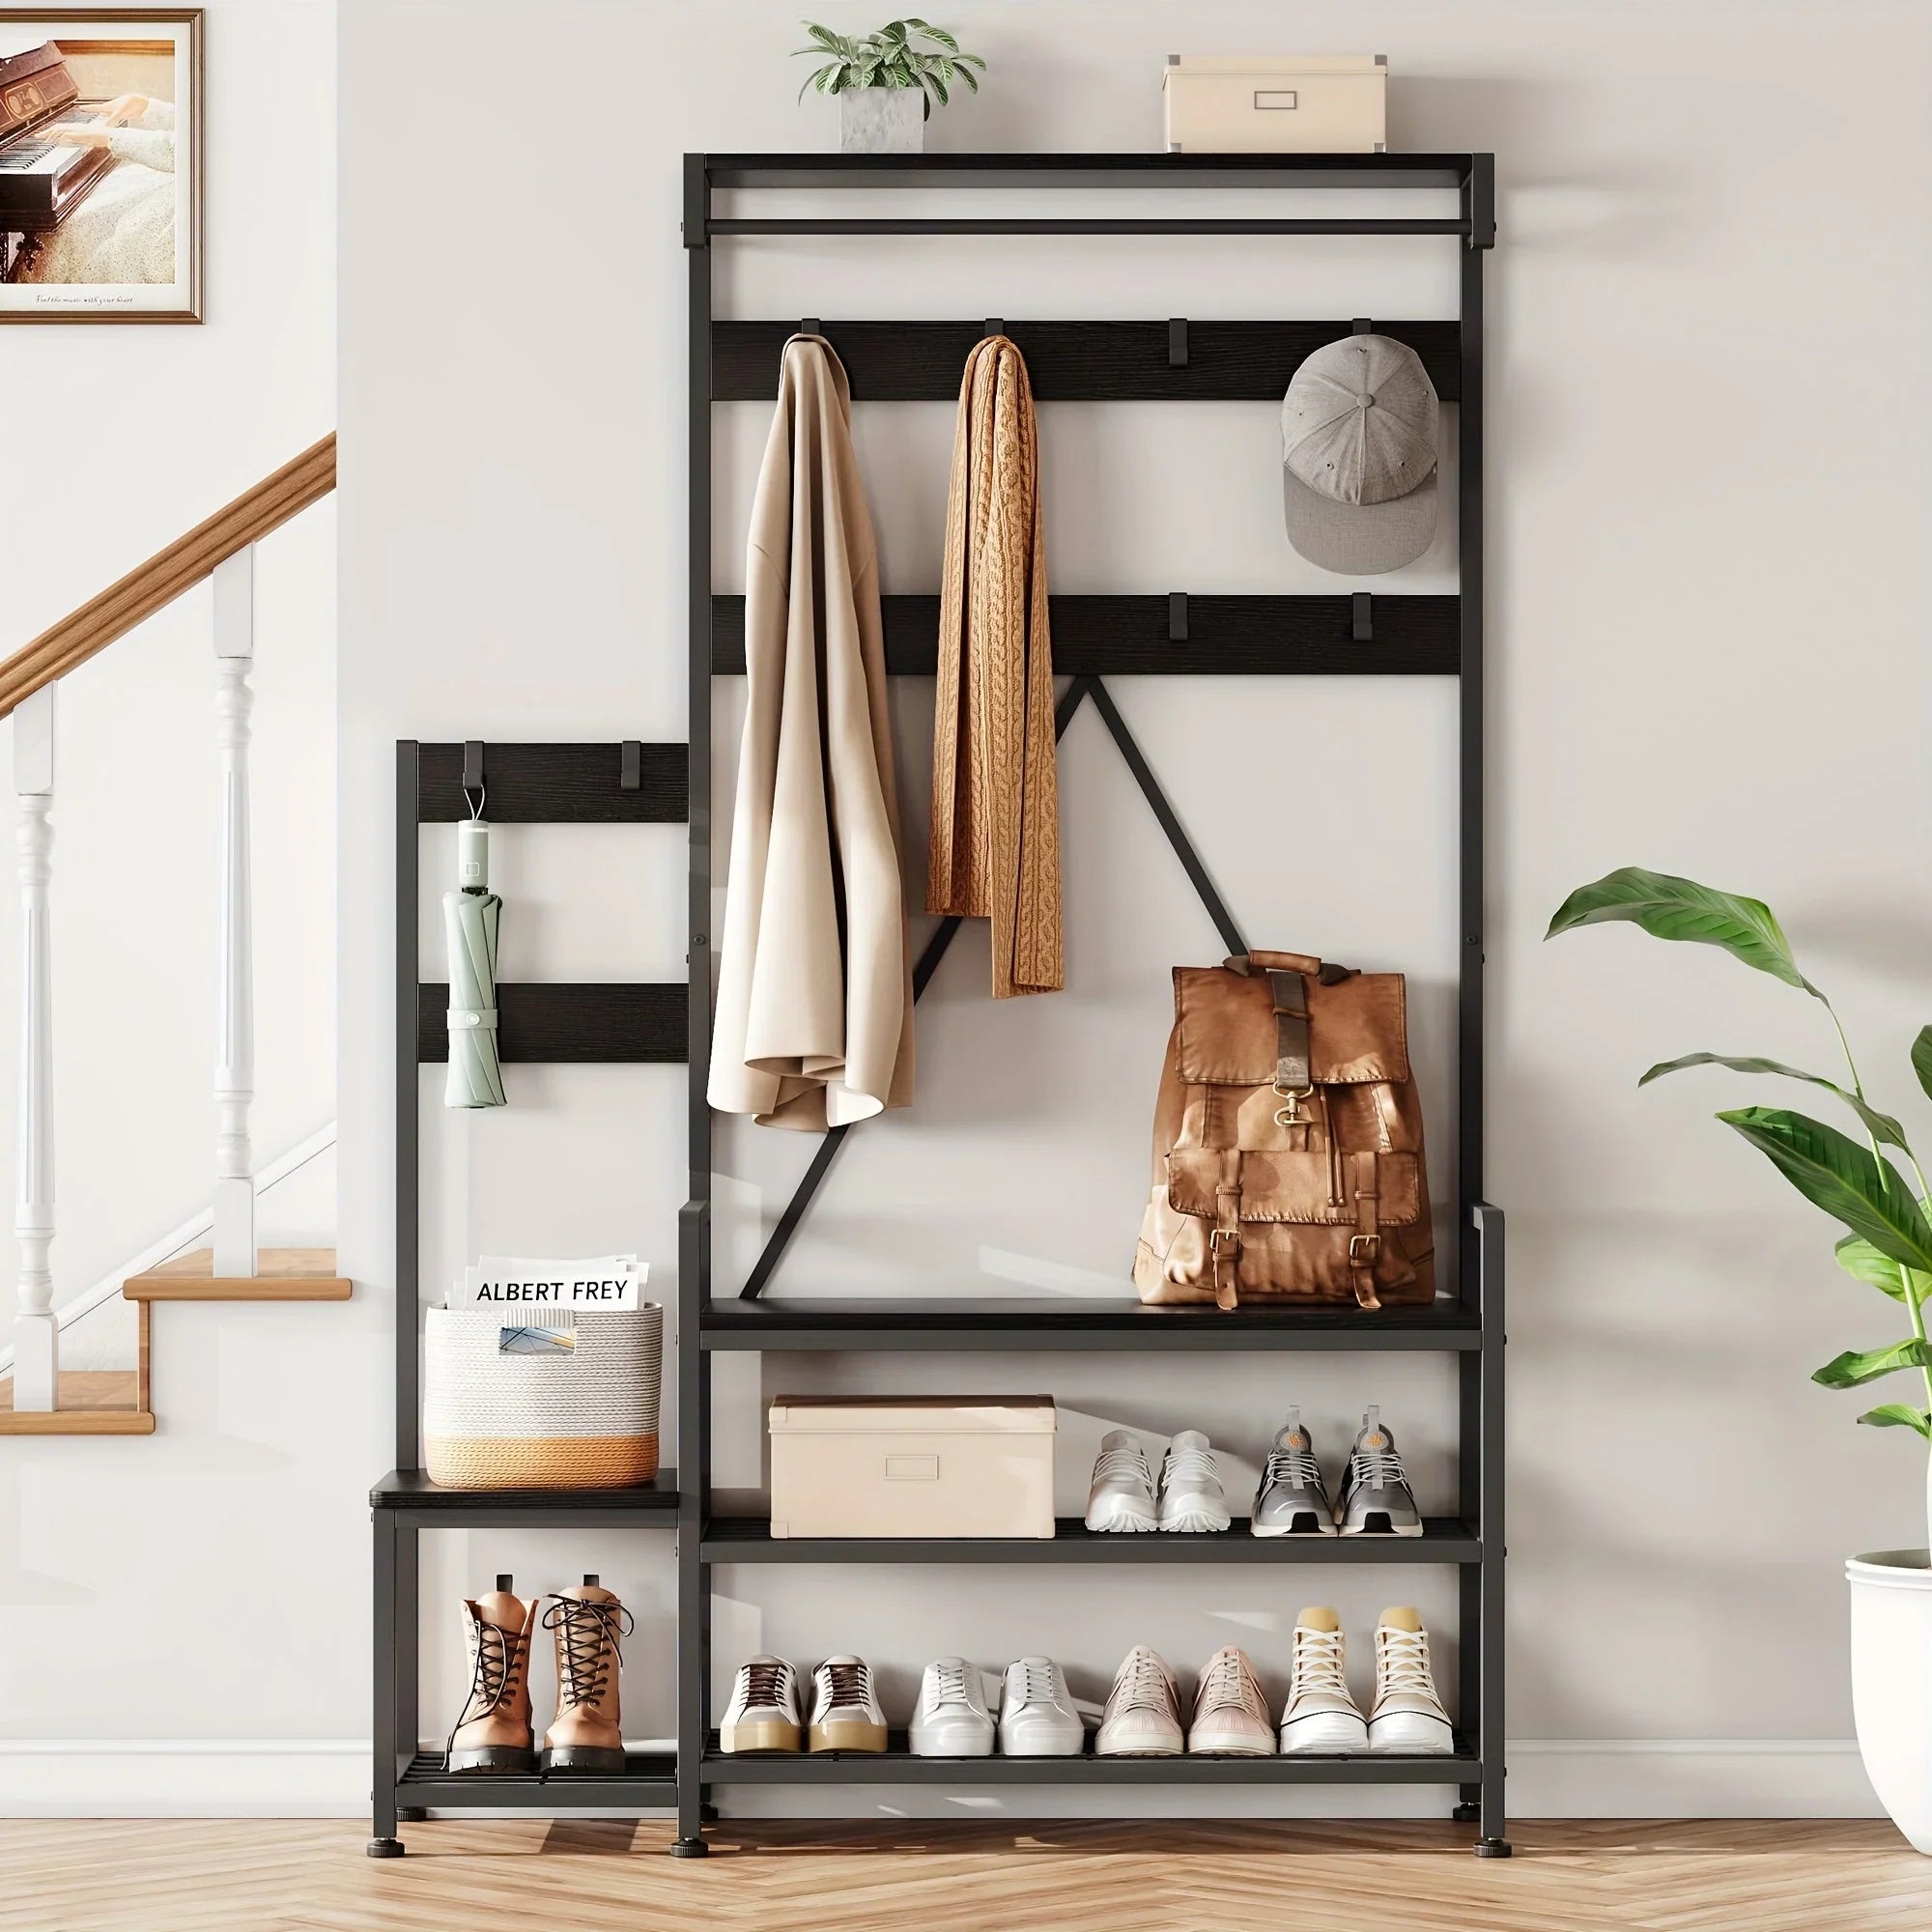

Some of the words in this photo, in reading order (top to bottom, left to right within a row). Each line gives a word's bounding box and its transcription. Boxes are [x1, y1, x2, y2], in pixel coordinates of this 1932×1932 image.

[98, 298, 114, 306] your
[476, 1282, 564, 1301] ALBERT
[573, 1279, 628, 1300] FREY
